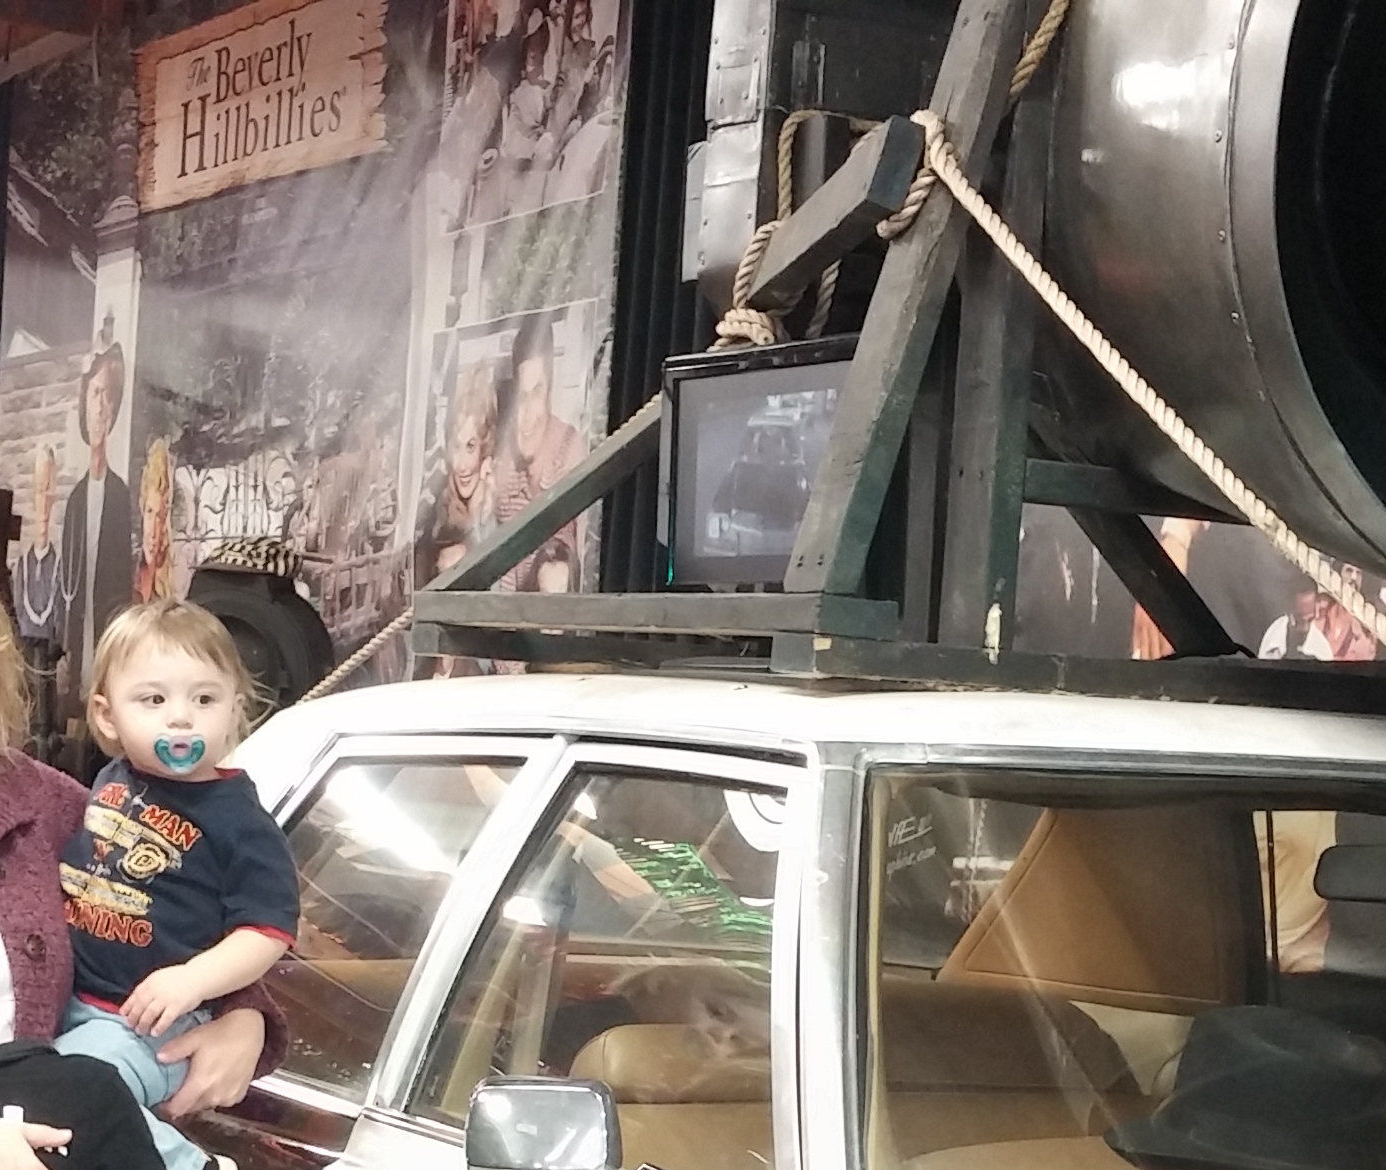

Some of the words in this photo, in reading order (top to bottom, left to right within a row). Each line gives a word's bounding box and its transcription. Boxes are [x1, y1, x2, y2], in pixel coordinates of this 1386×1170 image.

[186, 56, 211, 92] The
[213, 17, 313, 105] Beverly
[177, 82, 342, 179] Hillbillies
[138, 804, 203, 851] MAN
